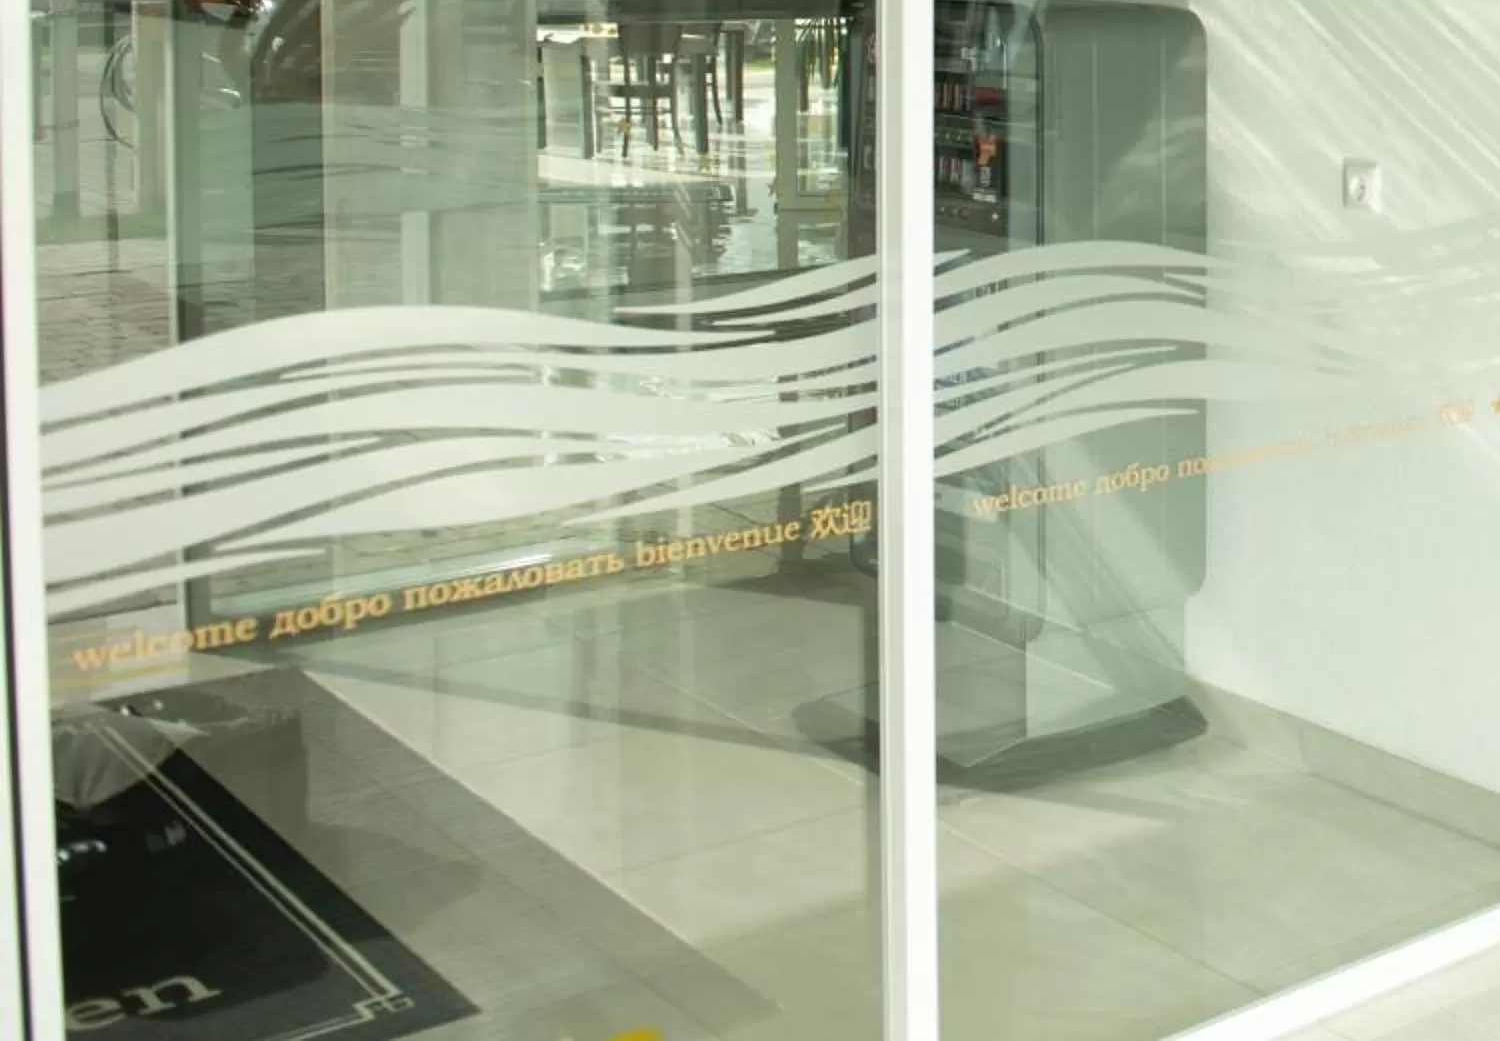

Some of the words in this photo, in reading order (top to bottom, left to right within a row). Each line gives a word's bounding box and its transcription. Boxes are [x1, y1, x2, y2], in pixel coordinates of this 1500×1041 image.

[972, 480, 1087, 517] welcome
[71, 615, 259, 673] welcome
[269, 592, 392, 640] добро
[402, 554, 623, 611] пожаловать
[635, 519, 801, 569] bienvenue
[809, 500, 873, 540] 欢迎
